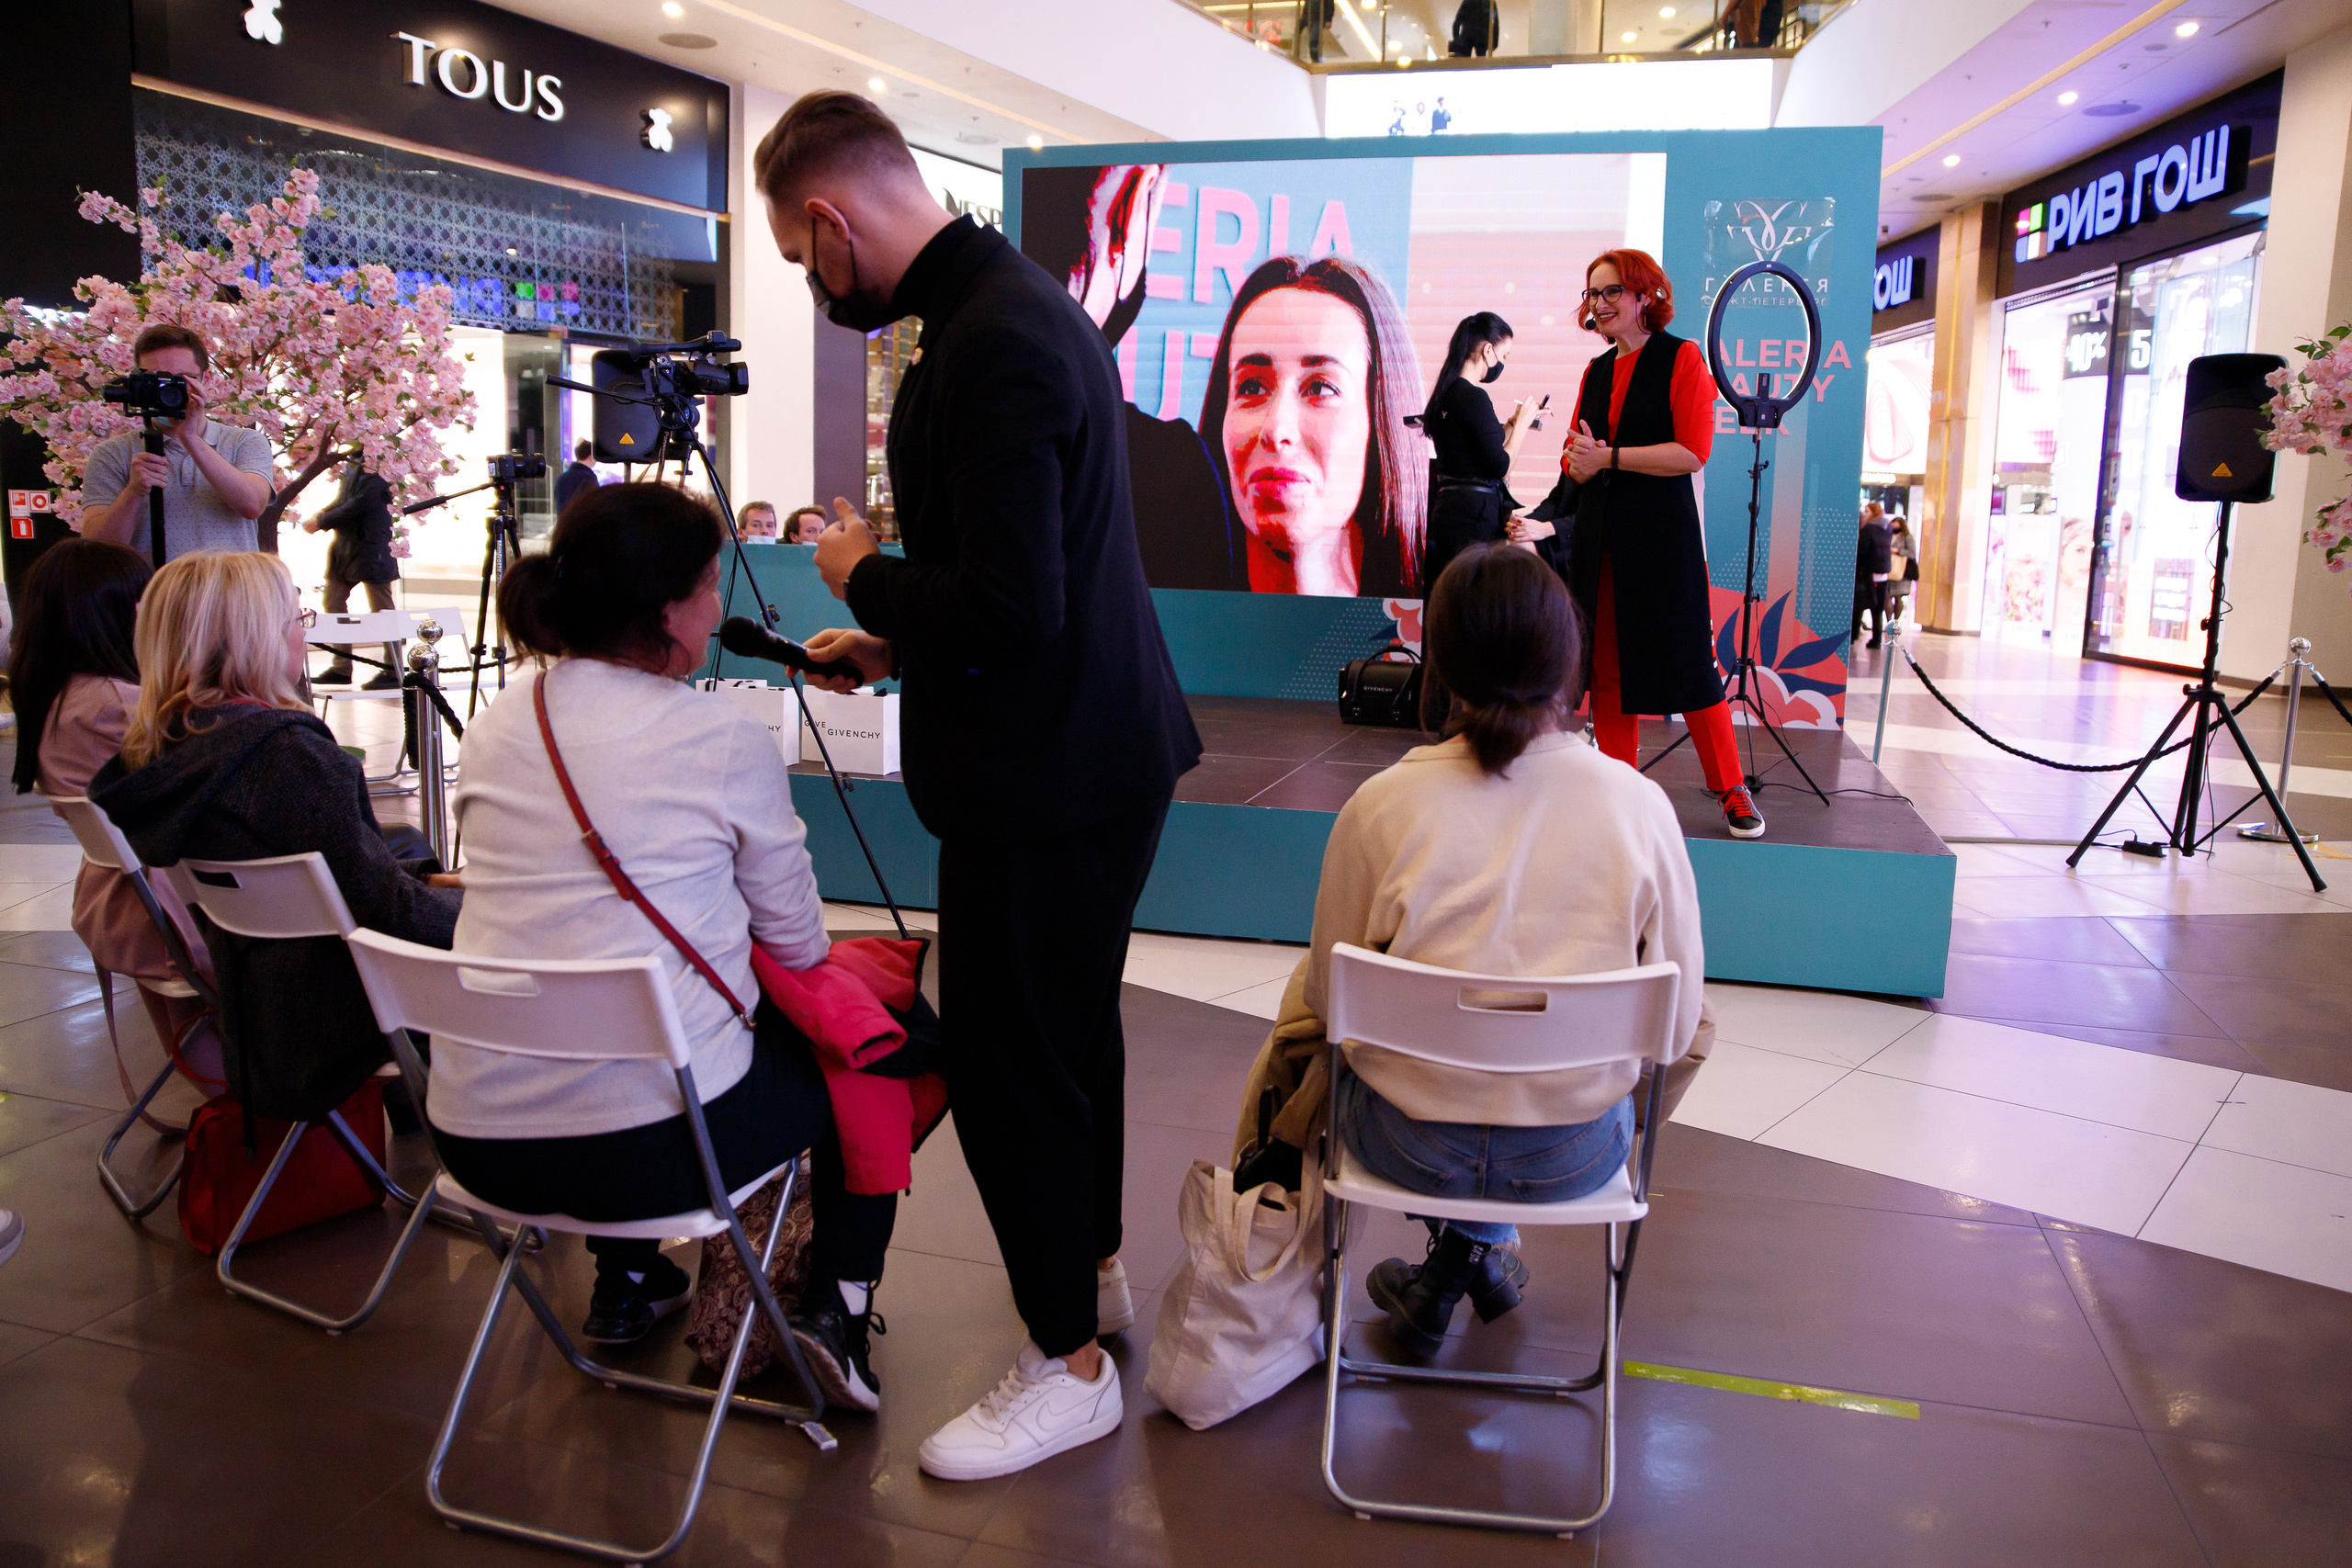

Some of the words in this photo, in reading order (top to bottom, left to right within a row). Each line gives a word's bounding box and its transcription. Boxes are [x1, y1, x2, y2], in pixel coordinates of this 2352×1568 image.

[393, 30, 565, 121] TOUS
[2046, 170, 2125, 254] РИВ
[2130, 124, 2230, 224] ГОШ
[1705, 276, 1828, 293] ГЛЕРЯ
[1873, 254, 1914, 310] ОШ
[1688, 338, 1851, 369] LERA
[804, 719, 826, 728] GVE
[827, 728, 881, 739] GIVENCHY
